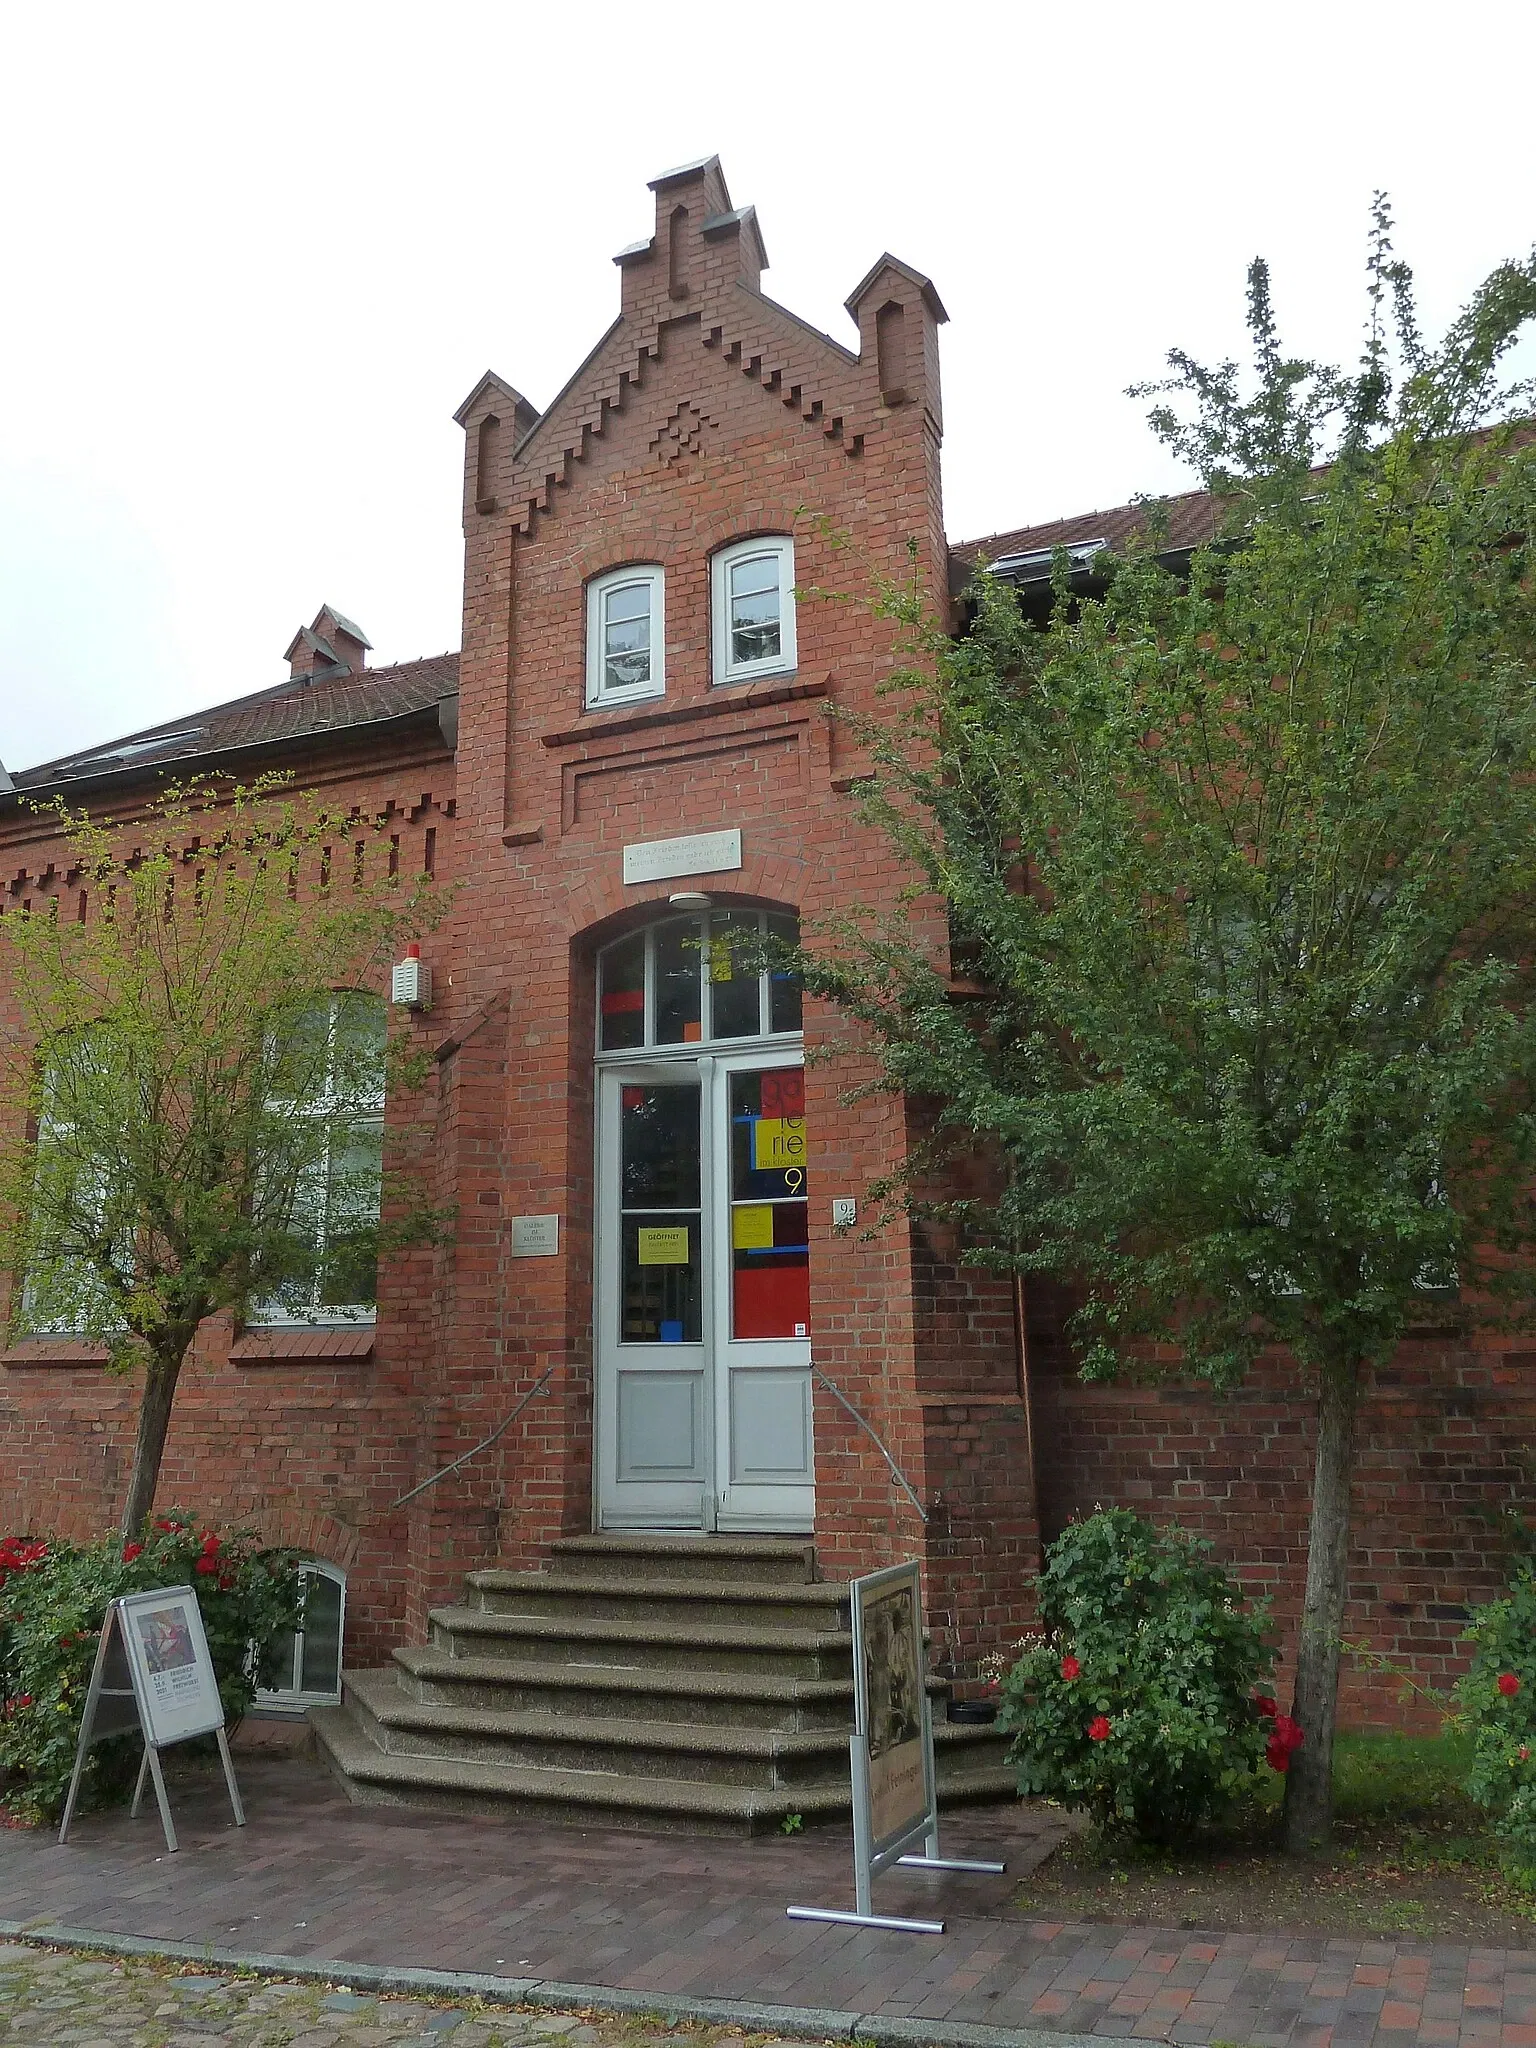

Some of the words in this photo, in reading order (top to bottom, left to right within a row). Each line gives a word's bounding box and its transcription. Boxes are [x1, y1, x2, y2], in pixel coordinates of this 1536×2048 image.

[772, 1131, 803, 1155] rie
[785, 1168, 802, 1194] 9
[840, 1202, 848, 1215] 9
[647, 1232, 680, 1241] GEÖFFNET
